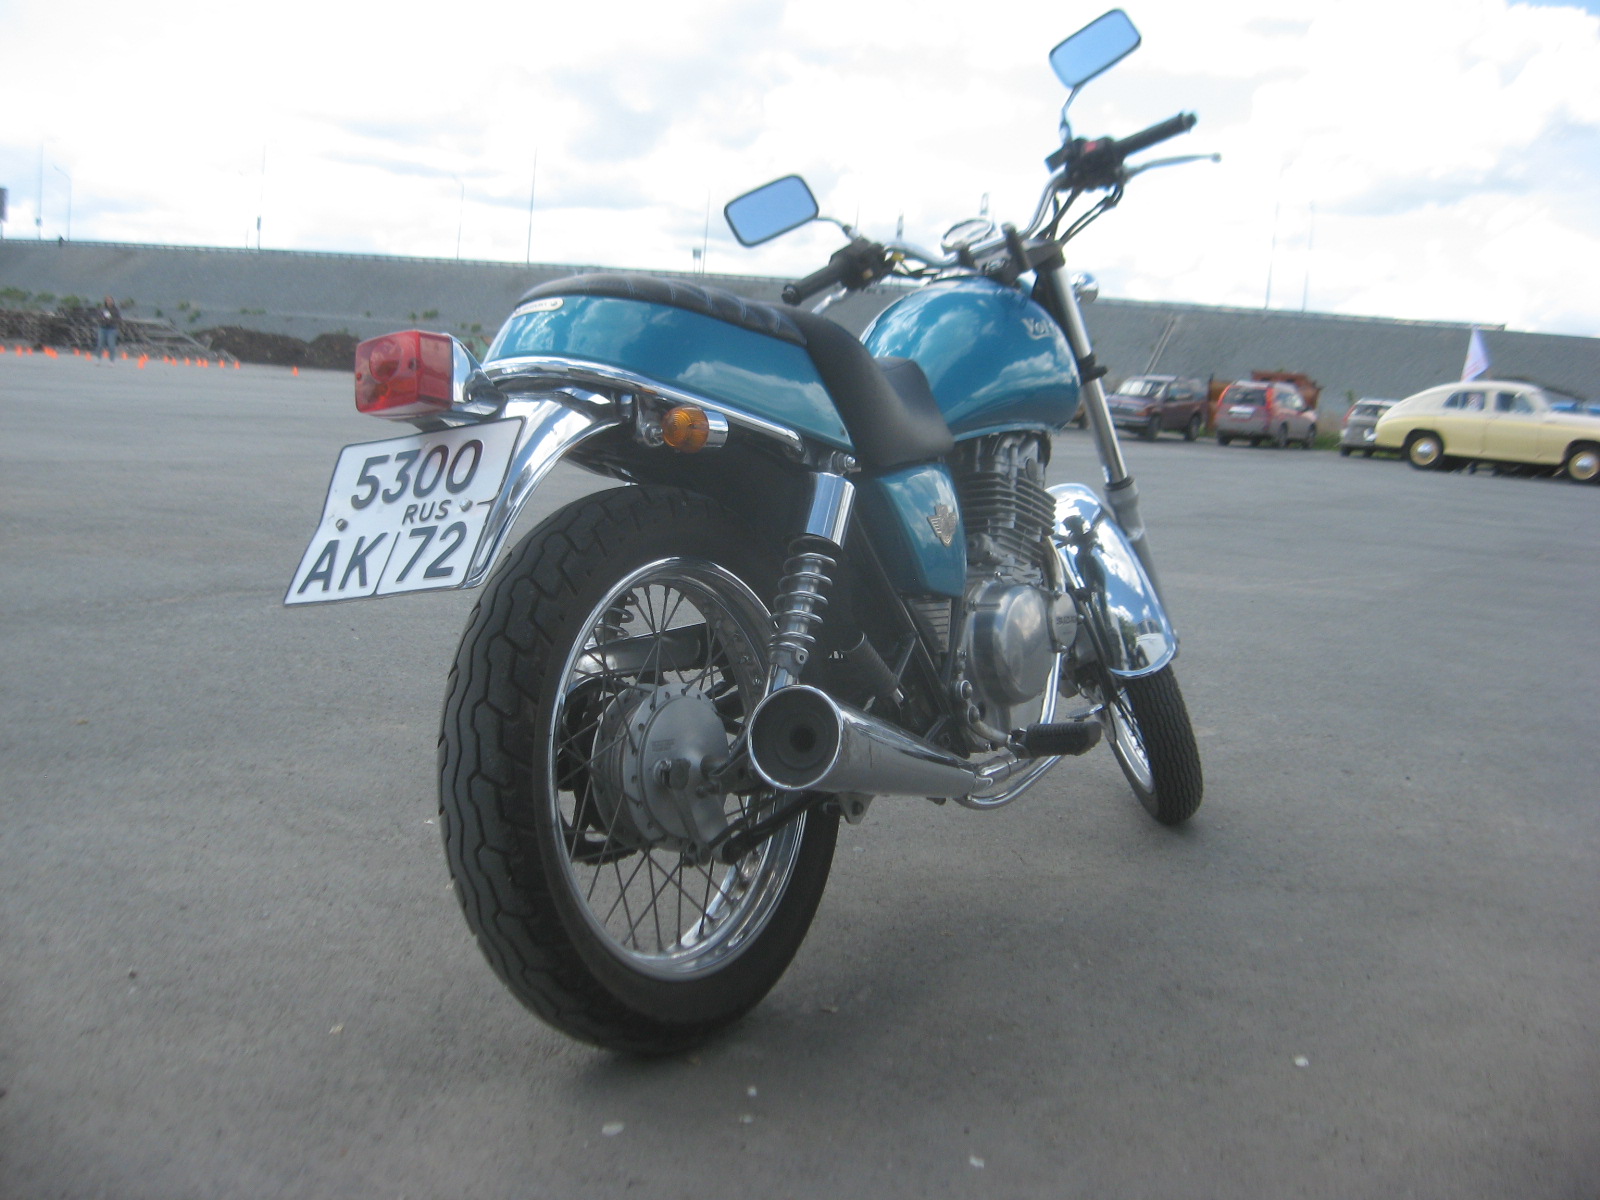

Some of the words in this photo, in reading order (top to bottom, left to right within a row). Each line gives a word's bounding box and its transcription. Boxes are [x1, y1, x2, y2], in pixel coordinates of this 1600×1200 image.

[351, 439, 484, 510] 5300
[402, 500, 452, 525] RUS
[297, 532, 388, 594] AK
[395, 521, 467, 584] 72
